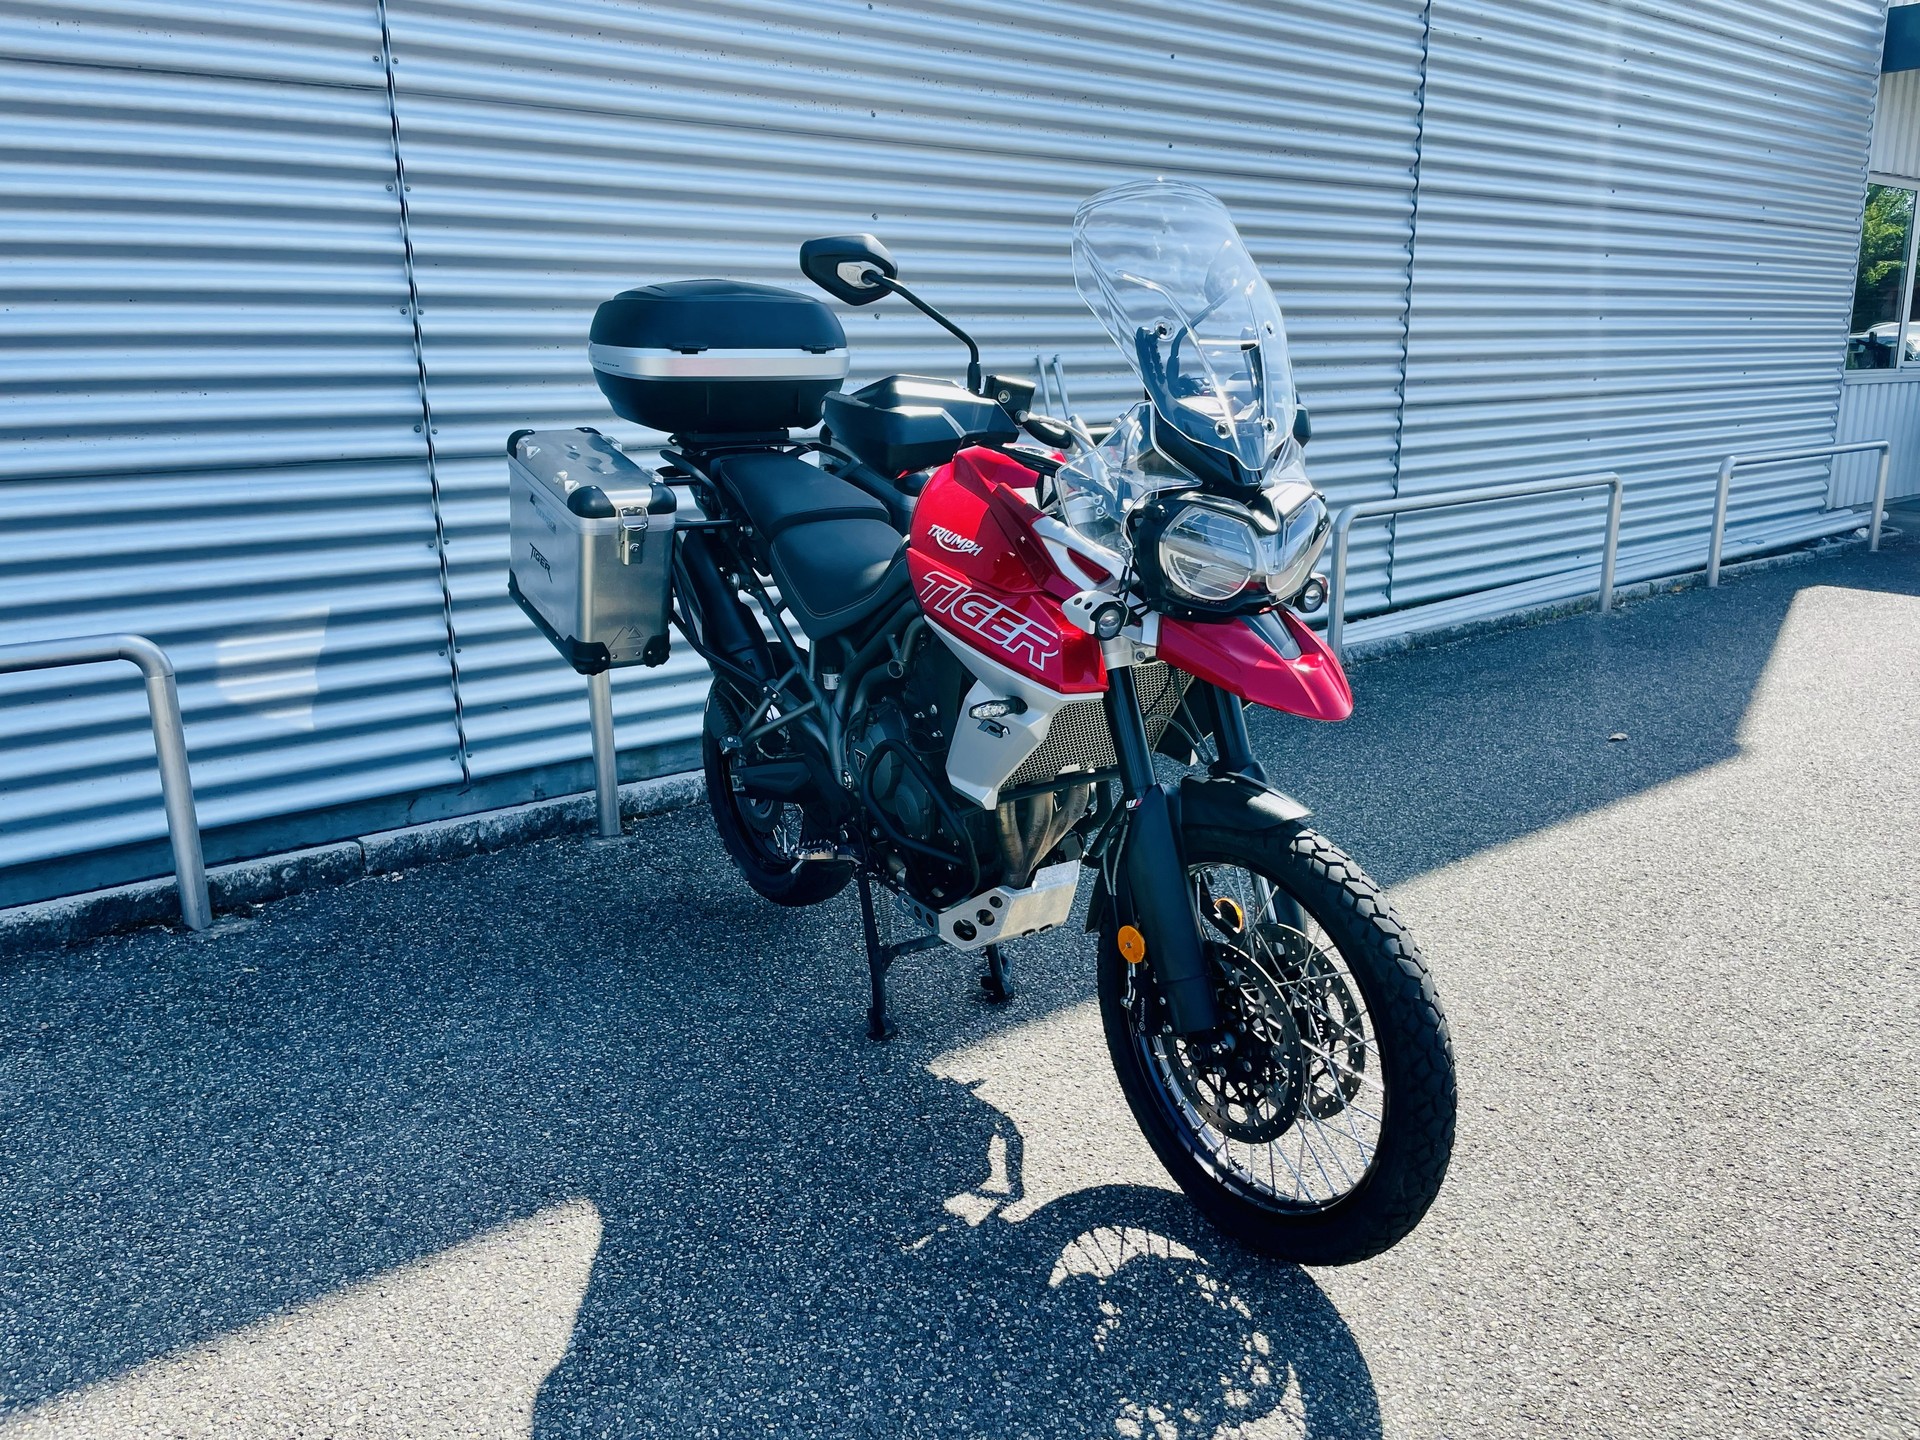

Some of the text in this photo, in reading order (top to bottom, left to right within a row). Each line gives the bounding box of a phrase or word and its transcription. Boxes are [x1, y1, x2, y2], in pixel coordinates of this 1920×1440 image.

[927, 524, 983, 556] TRIUMPH
[529, 542, 553, 583] TIGER
[920, 571, 1059, 671] TIGER
